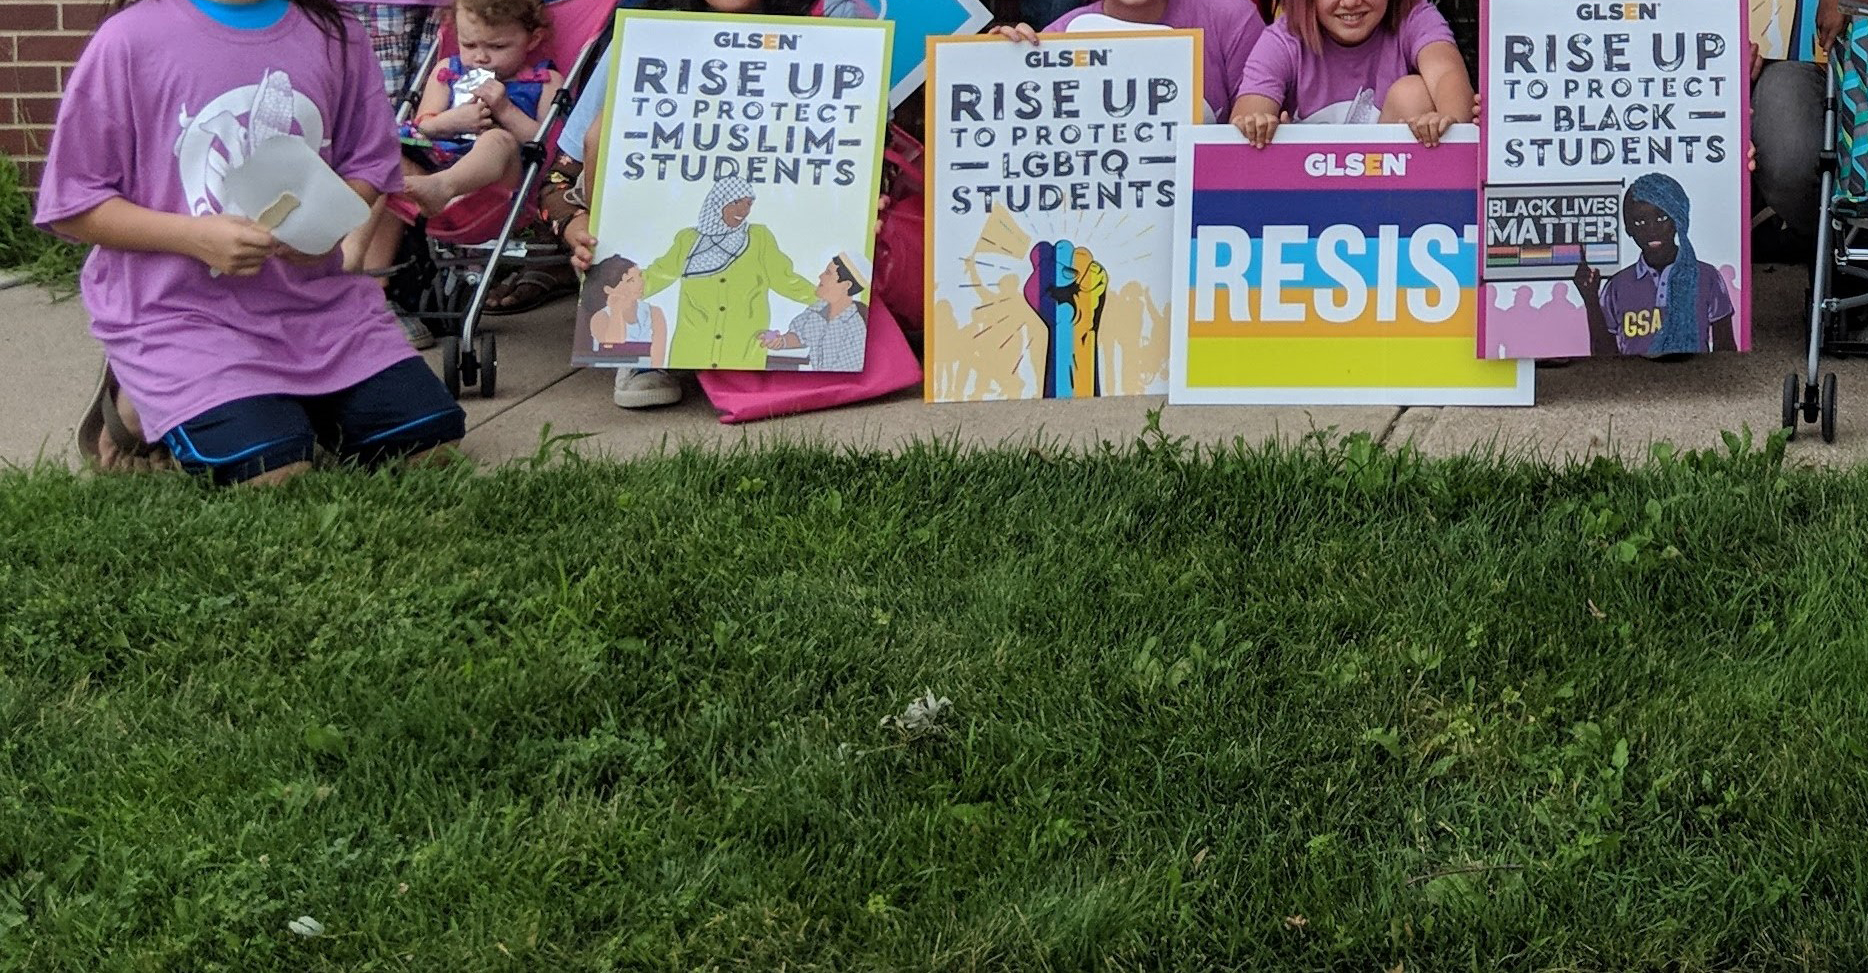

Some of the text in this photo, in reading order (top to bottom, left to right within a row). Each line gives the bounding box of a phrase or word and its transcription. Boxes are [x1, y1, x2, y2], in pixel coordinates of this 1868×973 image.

[1577, 3, 1657, 21] GLSEN
[714, 31, 798, 51] GLSEN
[1503, 32, 1725, 74] RISE UP
[1024, 49, 1108, 68] GLSEN
[634, 57, 864, 100] RISE UP
[1504, 77, 1725, 99] TO PROTECT
[632, 98, 861, 123] TO PROTECT
[951, 78, 1178, 122] RISE UP
[1554, 103, 1677, 132] BLACK
[651, 122, 835, 155] MUSLIM
[951, 121, 1178, 147] TO PROTECT
[1002, 149, 1129, 179] LGBTQ
[1304, 153, 1407, 177] GLSEN
[1504, 135, 1725, 167] STUDENTS
[623, 153, 855, 186] STUDENTS
[951, 180, 1175, 215] STUDENTS
[1488, 196, 1618, 216] BLACK LIVES
[1487, 216, 1618, 246] MATTER
[1194, 223, 1478, 323] RESIS
[1623, 308, 1661, 339] GSA
